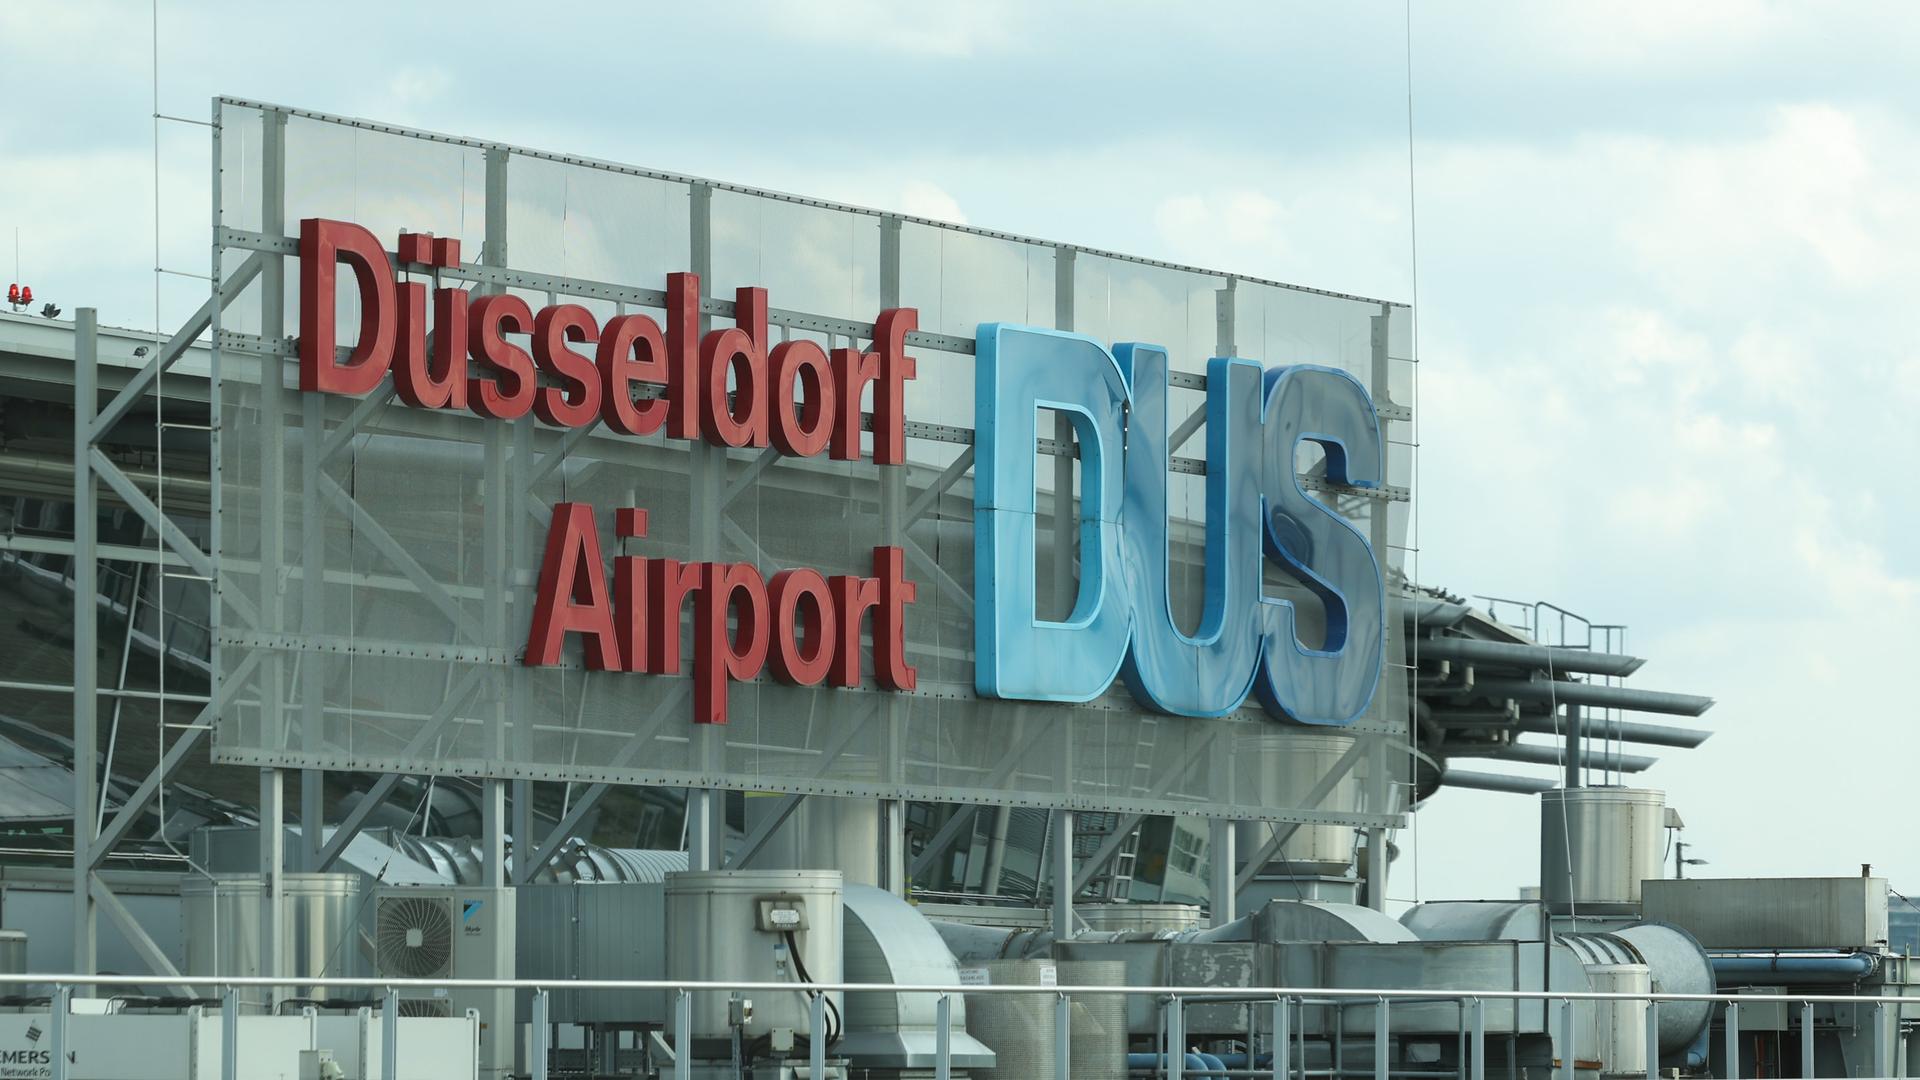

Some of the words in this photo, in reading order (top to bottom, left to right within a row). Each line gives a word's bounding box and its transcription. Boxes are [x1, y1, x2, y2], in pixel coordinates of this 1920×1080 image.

[300, 218, 919, 466] Düsseldorf
[524, 502, 917, 725] Airport
[974, 322, 1384, 727] DUS
[0, 1050, 75, 1064] MERSN
